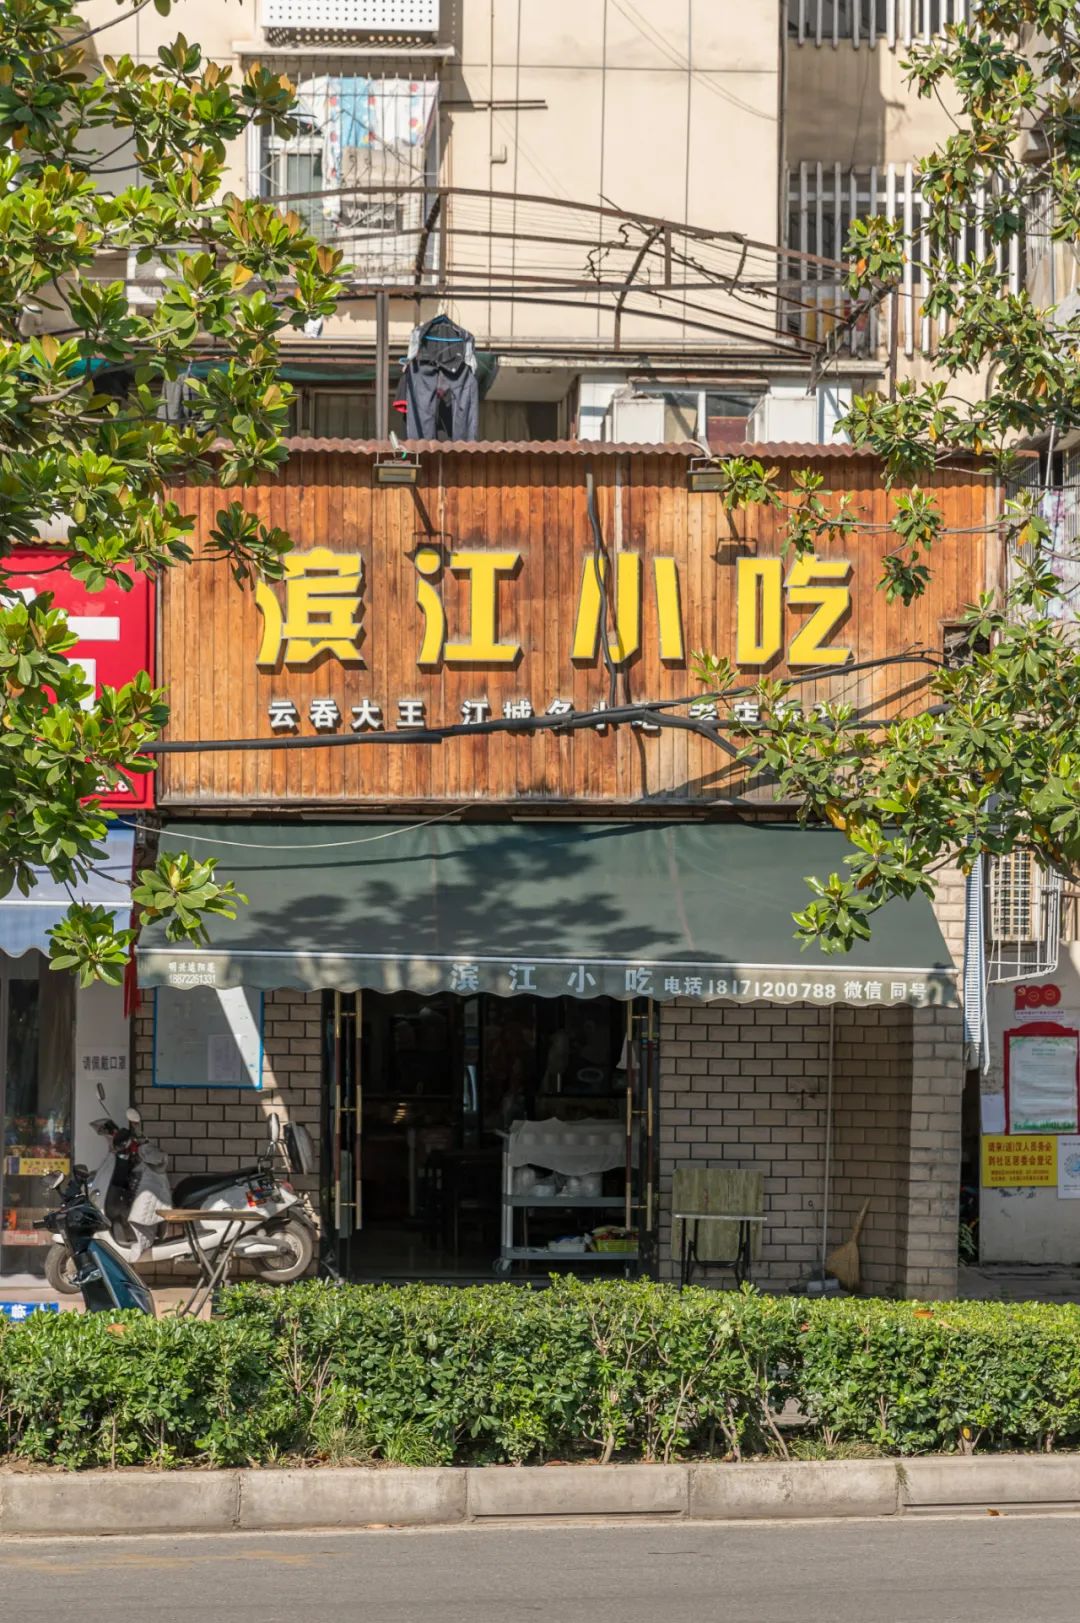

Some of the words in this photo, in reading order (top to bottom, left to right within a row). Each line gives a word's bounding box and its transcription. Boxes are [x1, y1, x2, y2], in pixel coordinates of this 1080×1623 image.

[255, 547, 853, 667] 滨江小吃
[268, 699, 426, 730] 云吞大王
[450, 963, 654, 995] 滨江小吃
